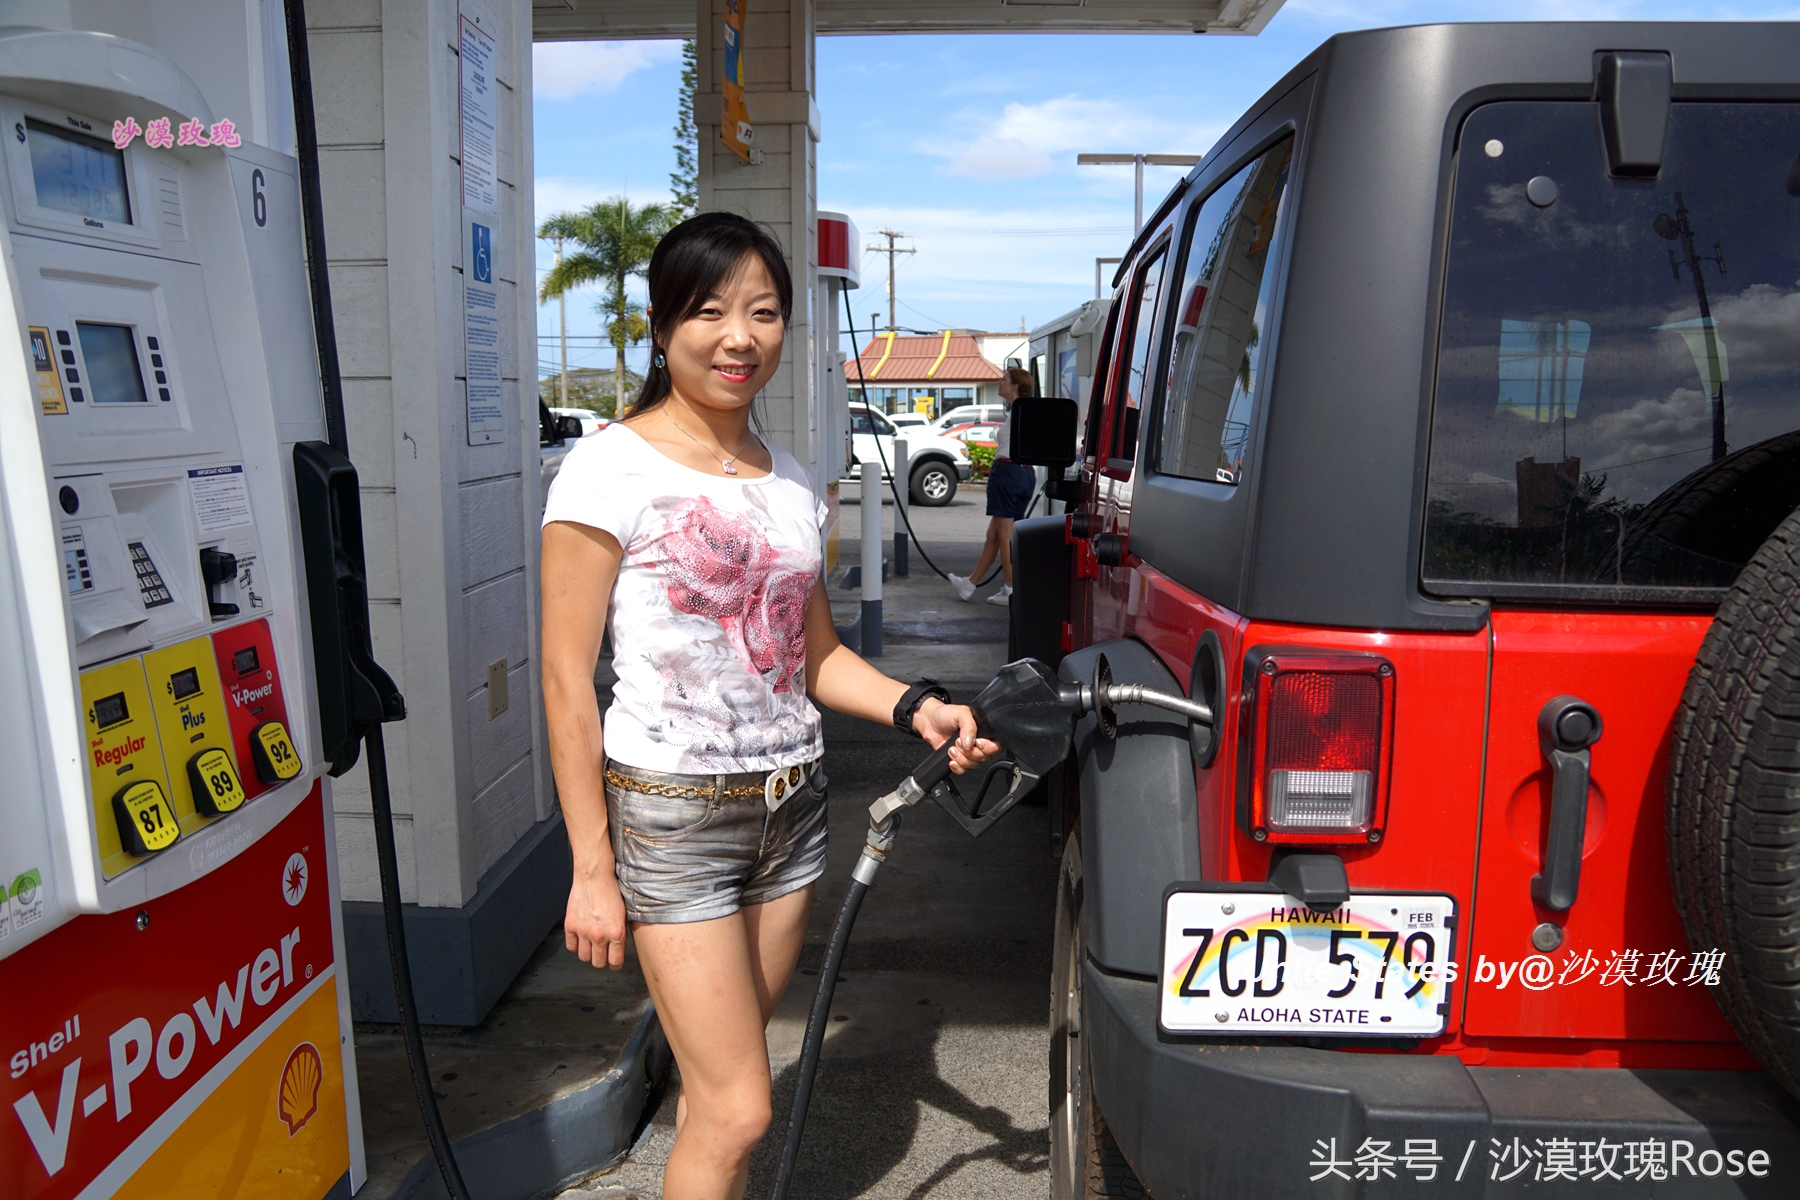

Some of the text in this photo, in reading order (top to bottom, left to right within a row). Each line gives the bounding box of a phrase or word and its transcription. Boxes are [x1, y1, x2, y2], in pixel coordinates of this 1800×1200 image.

[15, 122, 26, 144] $
[67, 116, 92, 131] This Sale
[252, 168, 266, 228] 6
[84, 218, 104, 229] Gallons
[167, 681, 172, 696] $
[232, 684, 272, 708] V-Power
[89, 708, 96, 724] $
[182, 710, 206, 731] Plus
[92, 738, 104, 748] Shell
[94, 735, 146, 768] Regular
[270, 740, 292, 764] 92
[210, 770, 234, 797] 89
[140, 804, 164, 834] 87
[148, 827, 176, 845] PRESS
[1270, 907, 1350, 924] HAWAII
[1410, 912, 1433, 922] FEB
[1179, 928, 1436, 1000] ZCD 579
[1237, 1008, 1370, 1024] ALOHA STATE
[10, 1014, 81, 1080] Shell
[12, 926, 301, 1178] V-Power
